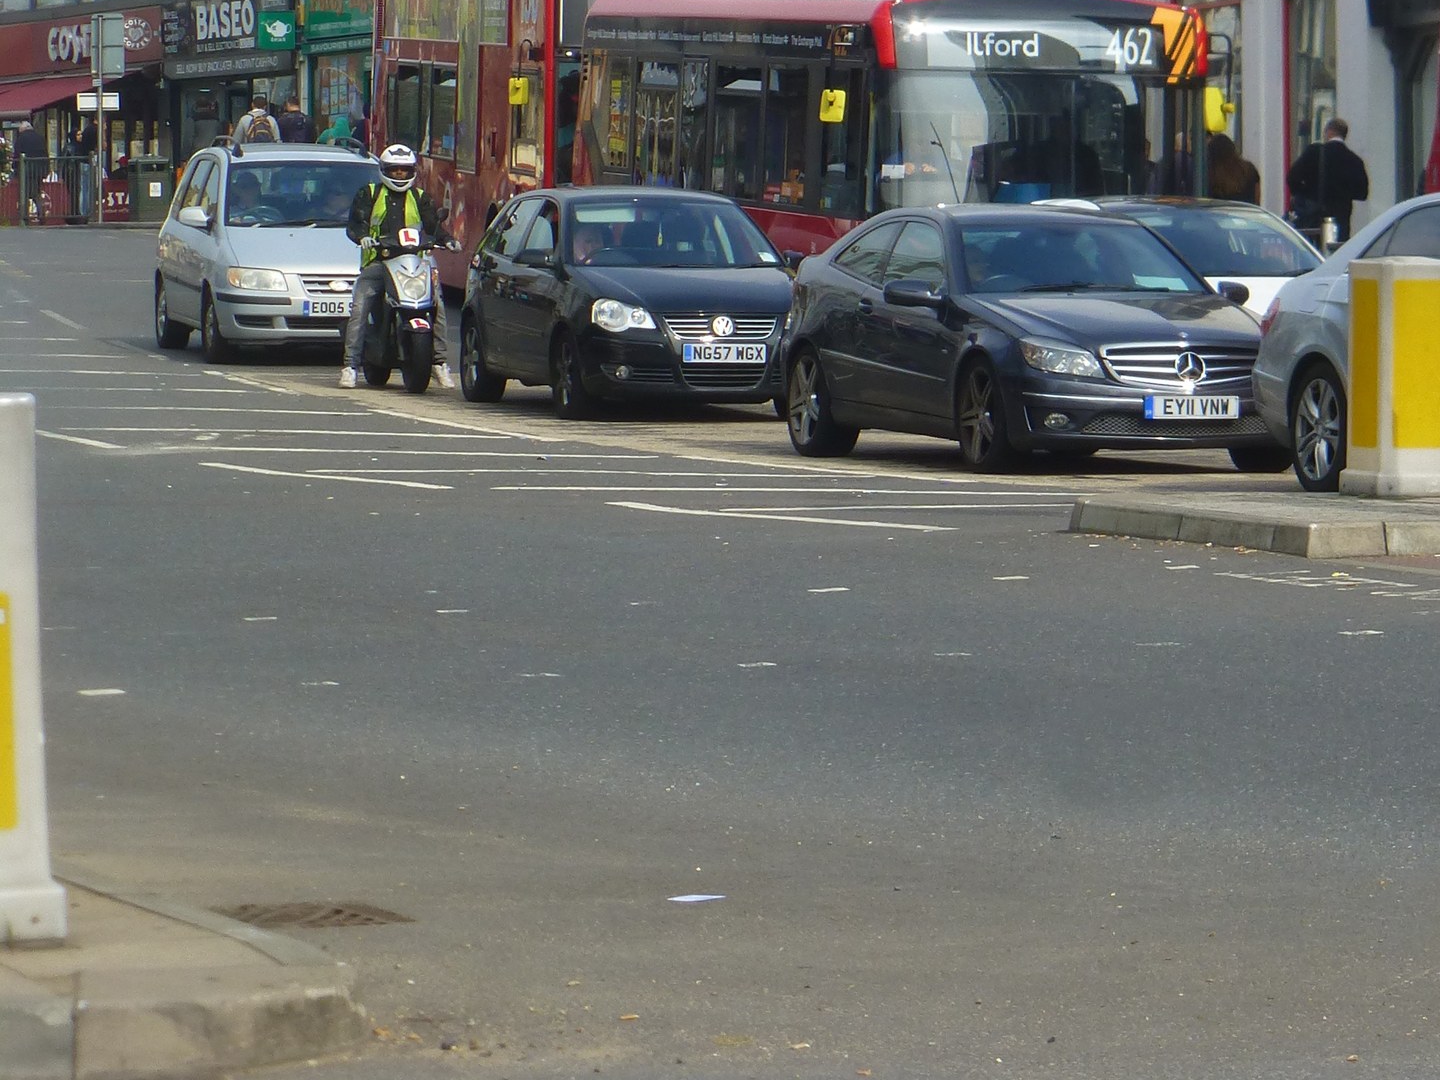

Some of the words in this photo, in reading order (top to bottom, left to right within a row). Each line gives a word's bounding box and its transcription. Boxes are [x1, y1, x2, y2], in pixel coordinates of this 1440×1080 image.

[48, 24, 91, 64] COST
[966, 30, 1039, 58] Ilford
[1105, 27, 1153, 66] 462
[403, 230, 417, 243] L
[414, 320, 428, 329] L
[693, 346, 731, 361] NG57
[736, 346, 764, 361] WGX
[1200, 398, 1230, 415] VNW
